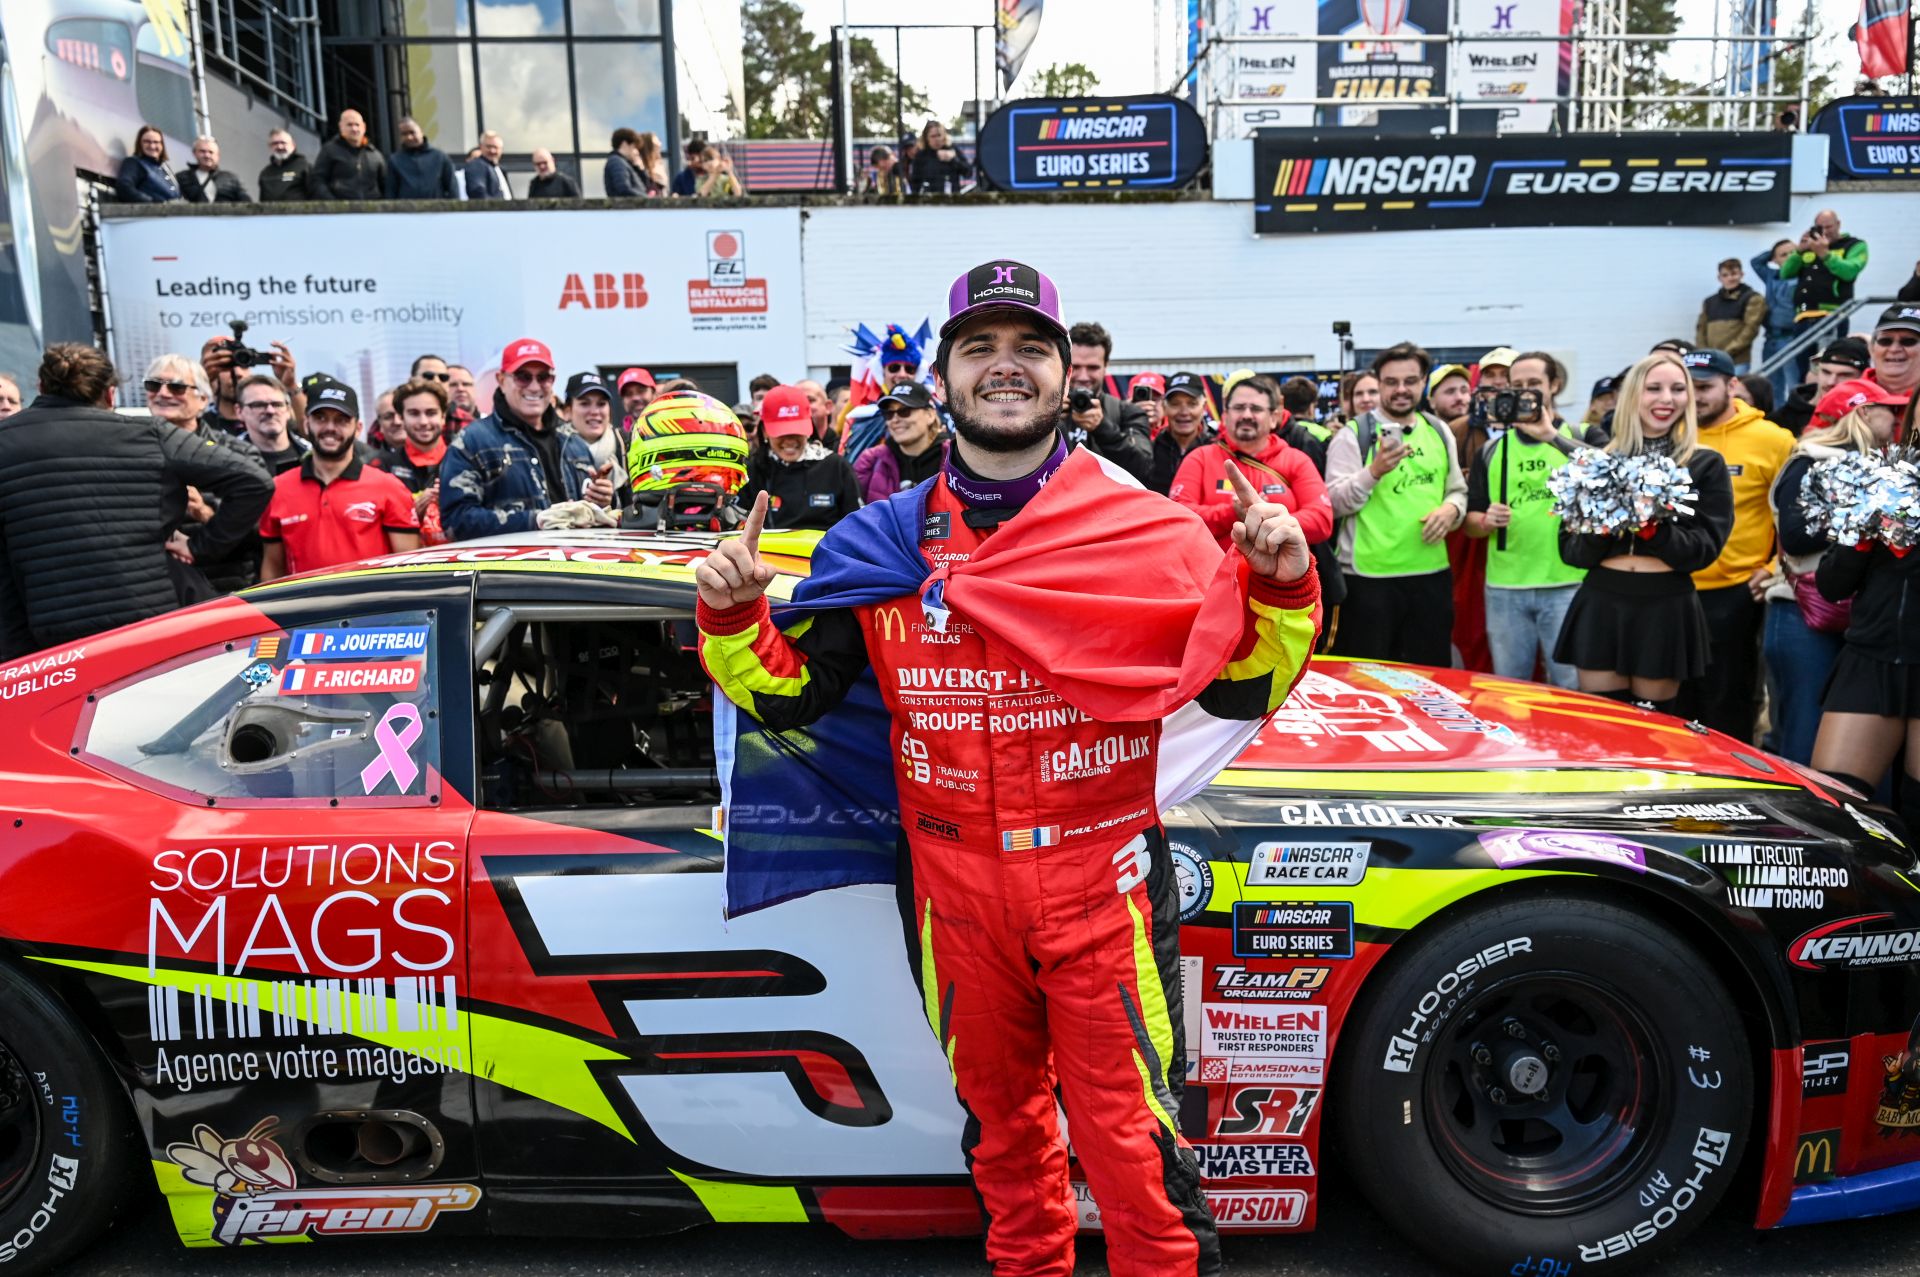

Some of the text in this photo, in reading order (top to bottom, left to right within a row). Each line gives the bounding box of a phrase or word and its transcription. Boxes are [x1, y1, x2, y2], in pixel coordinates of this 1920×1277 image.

[1469, 53, 1537, 67] WHELEN
[1333, 79, 1431, 98] FINALS
[1064, 115, 1147, 140] NASCAR
[1867, 145, 1920, 164] EURO S
[1036, 152, 1150, 177] EURO SERIES
[1321, 155, 1476, 196] NASCAR
[1506, 170, 1777, 195] EURO SERIES
[714, 262, 741, 275] EL
[156, 274, 377, 300] Leading the future
[558, 273, 649, 310] ABB
[974, 286, 1034, 300] HOOSIER
[159, 302, 464, 328] to zero emission e-mobility
[1518, 460, 1546, 472] 139
[957, 482, 1002, 501] HOOSIER
[925, 545, 944, 553] UIT
[911, 622, 974, 634] FINCIERE
[323, 632, 426, 652] P. JOUFFREAU
[921, 634, 961, 644] PALLAS
[0, 667, 77, 700] UBLICS
[900, 695, 984, 707] CONSTRUCTIONS
[908, 711, 984, 731] GROUPE
[936, 765, 979, 780] TRAVAUX
[1053, 765, 1111, 782] PACKAGING
[935, 777, 976, 793] PUBLICS
[1064, 808, 1148, 838] PAUL JOUFFREAU
[1112, 833, 1151, 894] 3
[1288, 847, 1354, 862] NASCAR
[1753, 847, 1804, 866] CIRCUIT
[150, 841, 455, 892] SOLUTIONS
[1169, 842, 1212, 887] SINESS CLUB
[1265, 866, 1349, 879] RACE CAR
[1788, 867, 1849, 888] RICARDO
[1774, 888, 1824, 910] TORMO
[1274, 910, 1332, 924] NASCAR
[148, 888, 455, 979] MAGS
[1253, 935, 1333, 949] EURO SERIES
[1849, 953, 1910, 966] PERFORMANCE
[1223, 989, 1311, 999] ORGANIZATION
[1402, 937, 1533, 1039] HOOSIER
[1206, 1008, 1320, 1031] WHELEN
[1212, 1032, 1319, 1042] TRUSTED TO PROTECT
[1218, 1043, 1314, 1053] FIRST RESPONDERS
[156, 1036, 463, 1092] Agence votre magasin
[1232, 1064, 1321, 1074] SAMSONAS
[1803, 1075, 1839, 1088] TIJEY
[1207, 1160, 1310, 1178] MASTER
[1577, 1162, 1713, 1263] HOOSIER
